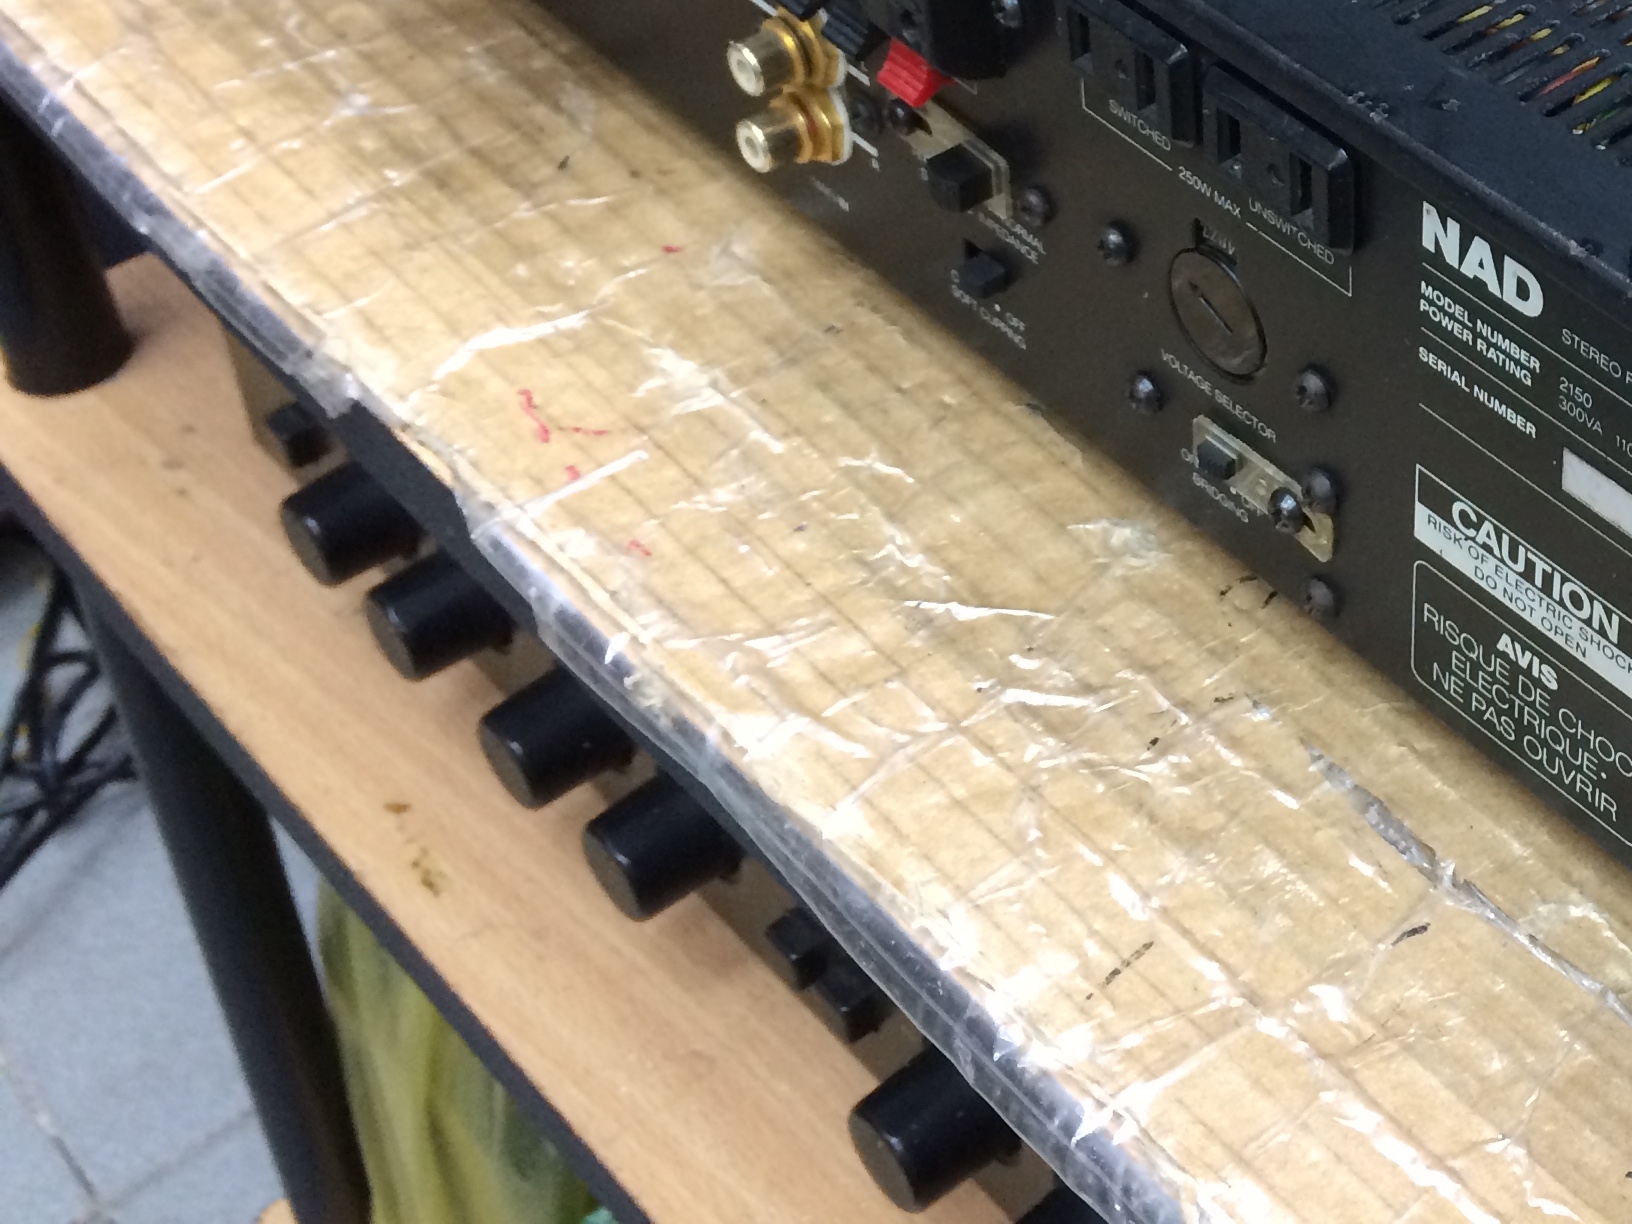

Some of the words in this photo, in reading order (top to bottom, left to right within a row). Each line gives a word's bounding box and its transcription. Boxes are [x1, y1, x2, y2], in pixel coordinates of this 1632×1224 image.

[1108, 99, 1171, 152] SWITCHED
[1003, 218, 1046, 255] ORMAL
[1178, 165, 1212, 199] 250W
[1214, 190, 1242, 219] MAX
[1248, 196, 1335, 266] UNSWITCHED
[1421, 200, 1545, 318] NAD
[1419, 299, 1473, 346] POWER
[1476, 338, 1532, 387] RATING
[1420, 280, 1473, 328] MODEL
[1476, 318, 1541, 374] NUMBER
[1561, 328, 1622, 378] STEREO
[1160, 348, 1213, 396] VOLTAGE
[1214, 388, 1277, 444] SELECTOR
[1418, 346, 1470, 393] SERIAL
[1473, 384, 1537, 439] NUMBER
[1558, 395, 1603, 436] 300VA
[1559, 376, 1593, 409] 2150
[1427, 513, 1464, 549] RISK
[1468, 542, 1490, 565] OF
[1494, 565, 1573, 630] ELECTRIC
[1451, 500, 1620, 645] CAUTION
[1474, 565, 1498, 590] DO
[1502, 585, 1536, 618] NOT
[1540, 616, 1588, 659] OPEN
[1423, 602, 1510, 686] RISQUE
[1517, 674, 1552, 717] DE
[1496, 633, 1559, 691] AVIS
[1432, 662, 1464, 703] NE
[1471, 692, 1516, 741] PAS
[1523, 735, 1618, 823] OUVRIR
[1451, 650, 1608, 781] ELECTRIQUE.
